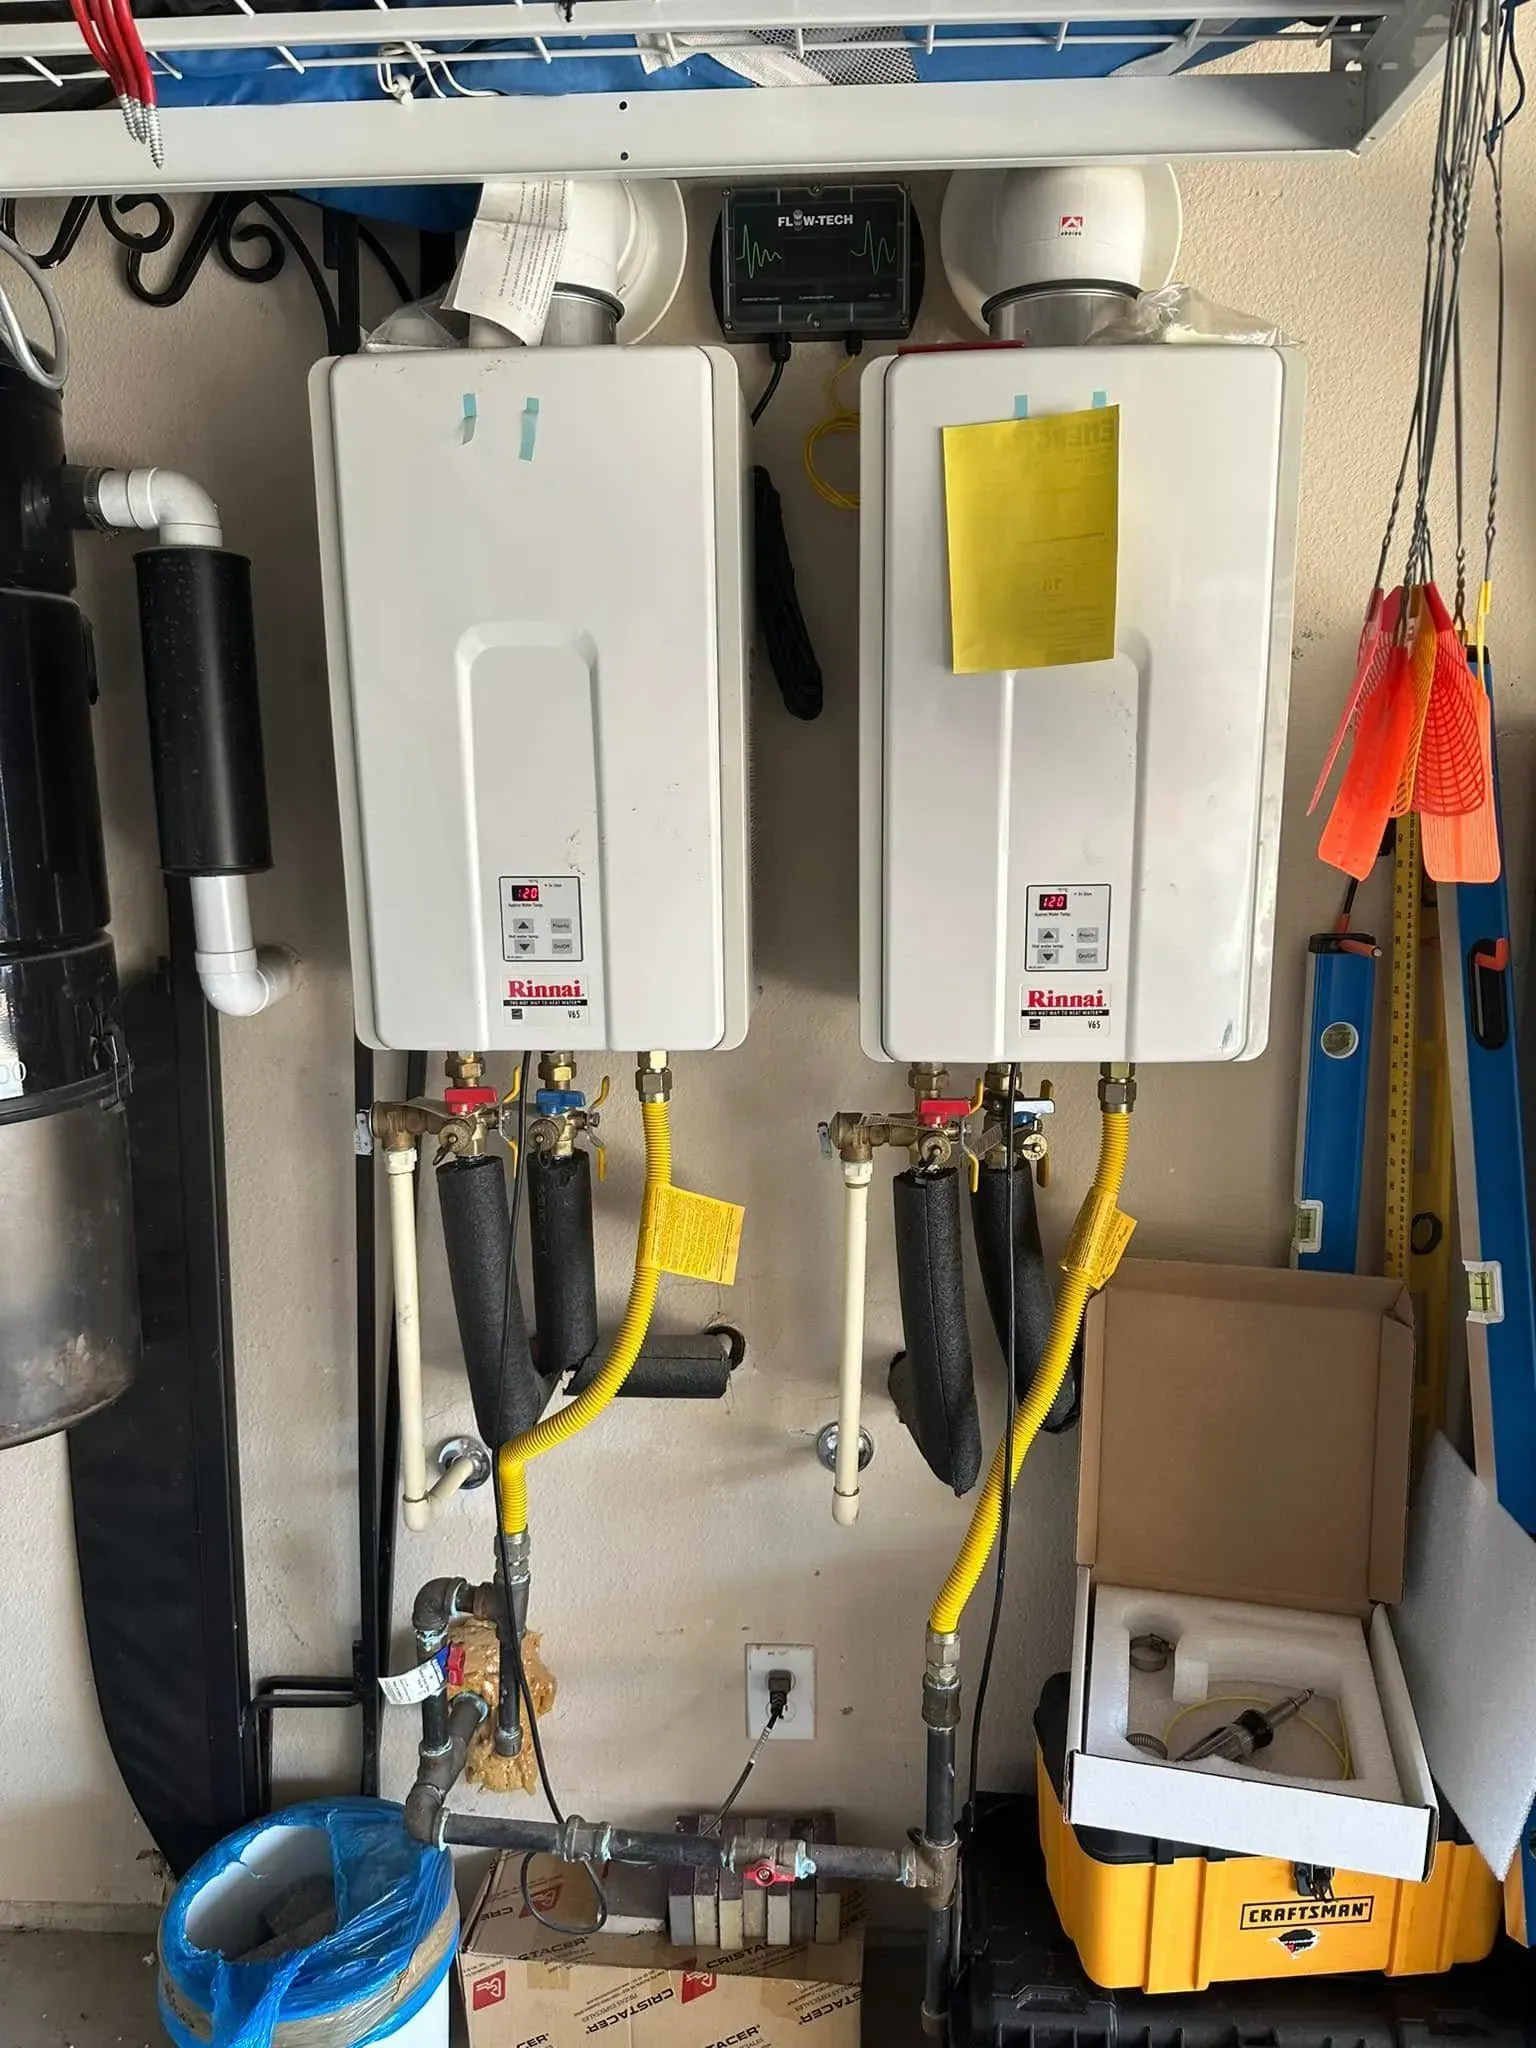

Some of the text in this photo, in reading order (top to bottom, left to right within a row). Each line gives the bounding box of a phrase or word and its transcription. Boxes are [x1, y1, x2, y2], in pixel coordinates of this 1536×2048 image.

[518, 888, 537, 899] 120
[1042, 896, 1065, 907] 120
[508, 980, 581, 998] Rinnai
[1028, 989, 1104, 1008] Rinnai
[568, 1010, 581, 1019] V65
[1088, 1020, 1101, 1029] V65
[1249, 1903, 1365, 1923] CRAFTSMAN
[589, 1988, 674, 2033] CRISTACER
